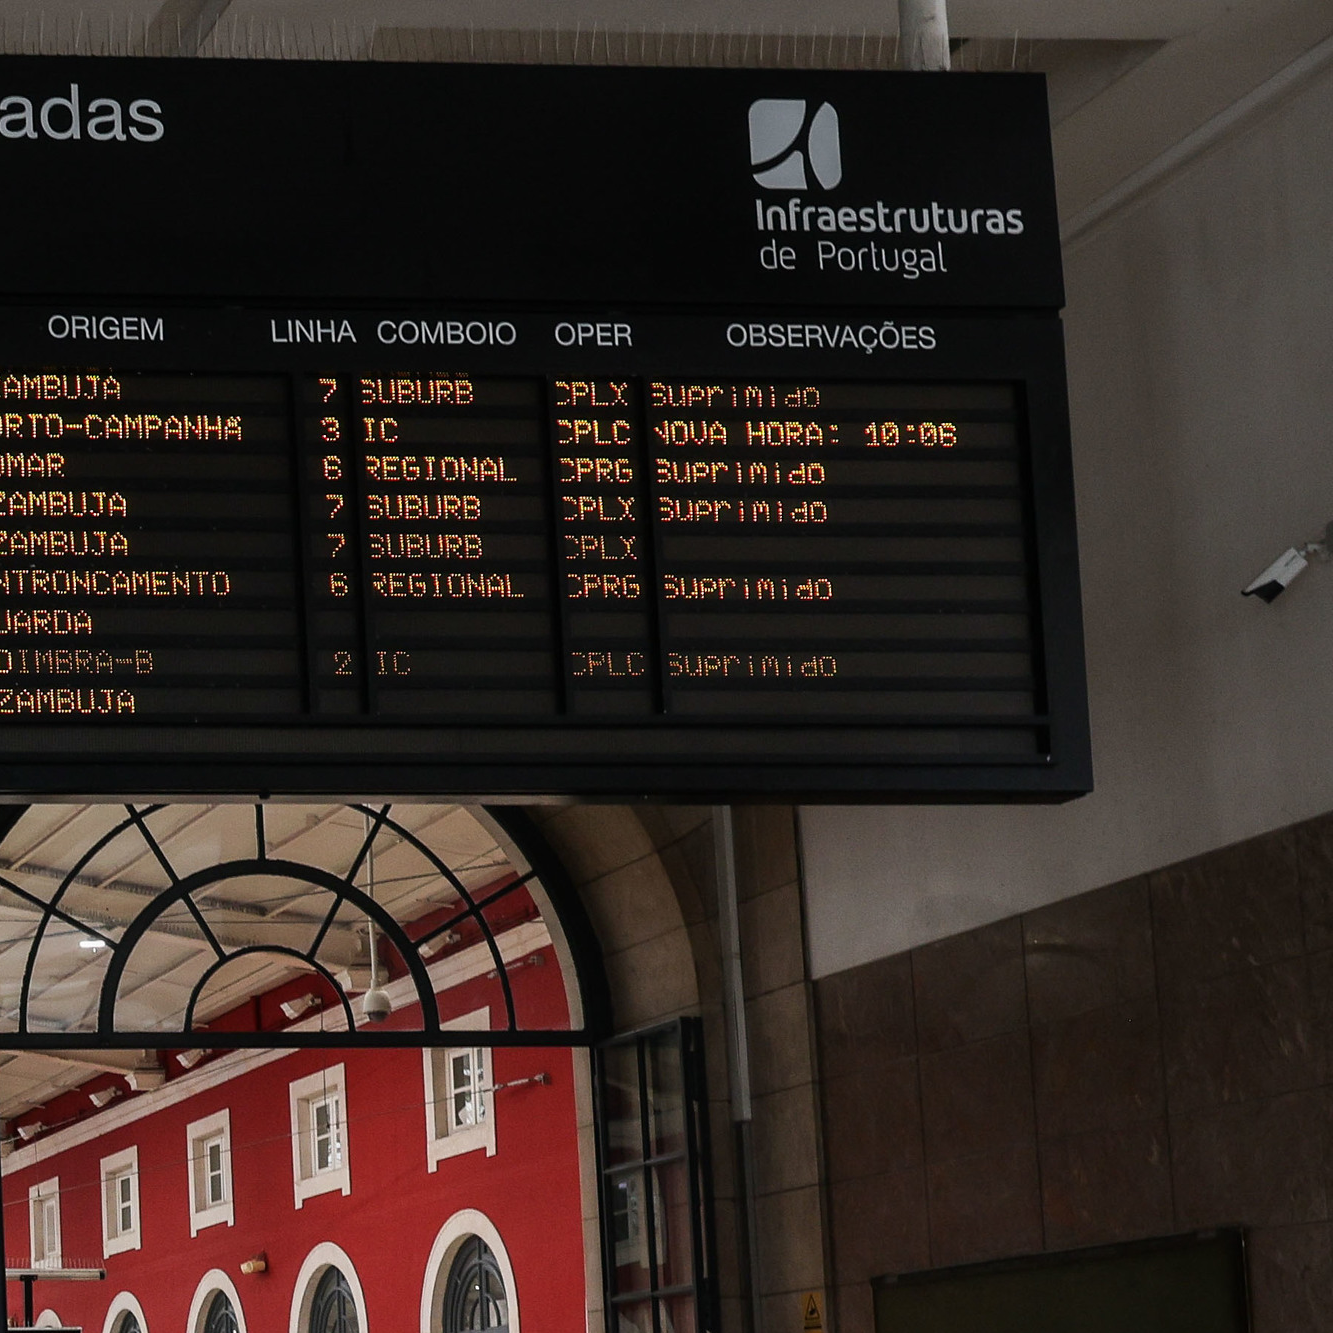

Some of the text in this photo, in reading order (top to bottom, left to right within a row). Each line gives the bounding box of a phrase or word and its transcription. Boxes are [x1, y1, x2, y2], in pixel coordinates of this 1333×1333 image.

[756, 199, 1023, 234] Infraestruturas
[761, 239, 947, 279] de Portugal
[49, 315, 163, 340] ORIGEM
[272, 320, 356, 342] LINHA
[378, 321, 516, 344] COMBOIO
[555, 323, 632, 346] OPER
[727, 322, 936, 353] OBSERVAÇÕES
[320, 417, 339, 441] 3
[363, 418, 398, 442] IC
[746, 421, 838, 446] HORA:
[865, 422, 956, 447] 10:06
[331, 573, 348, 596] 6
